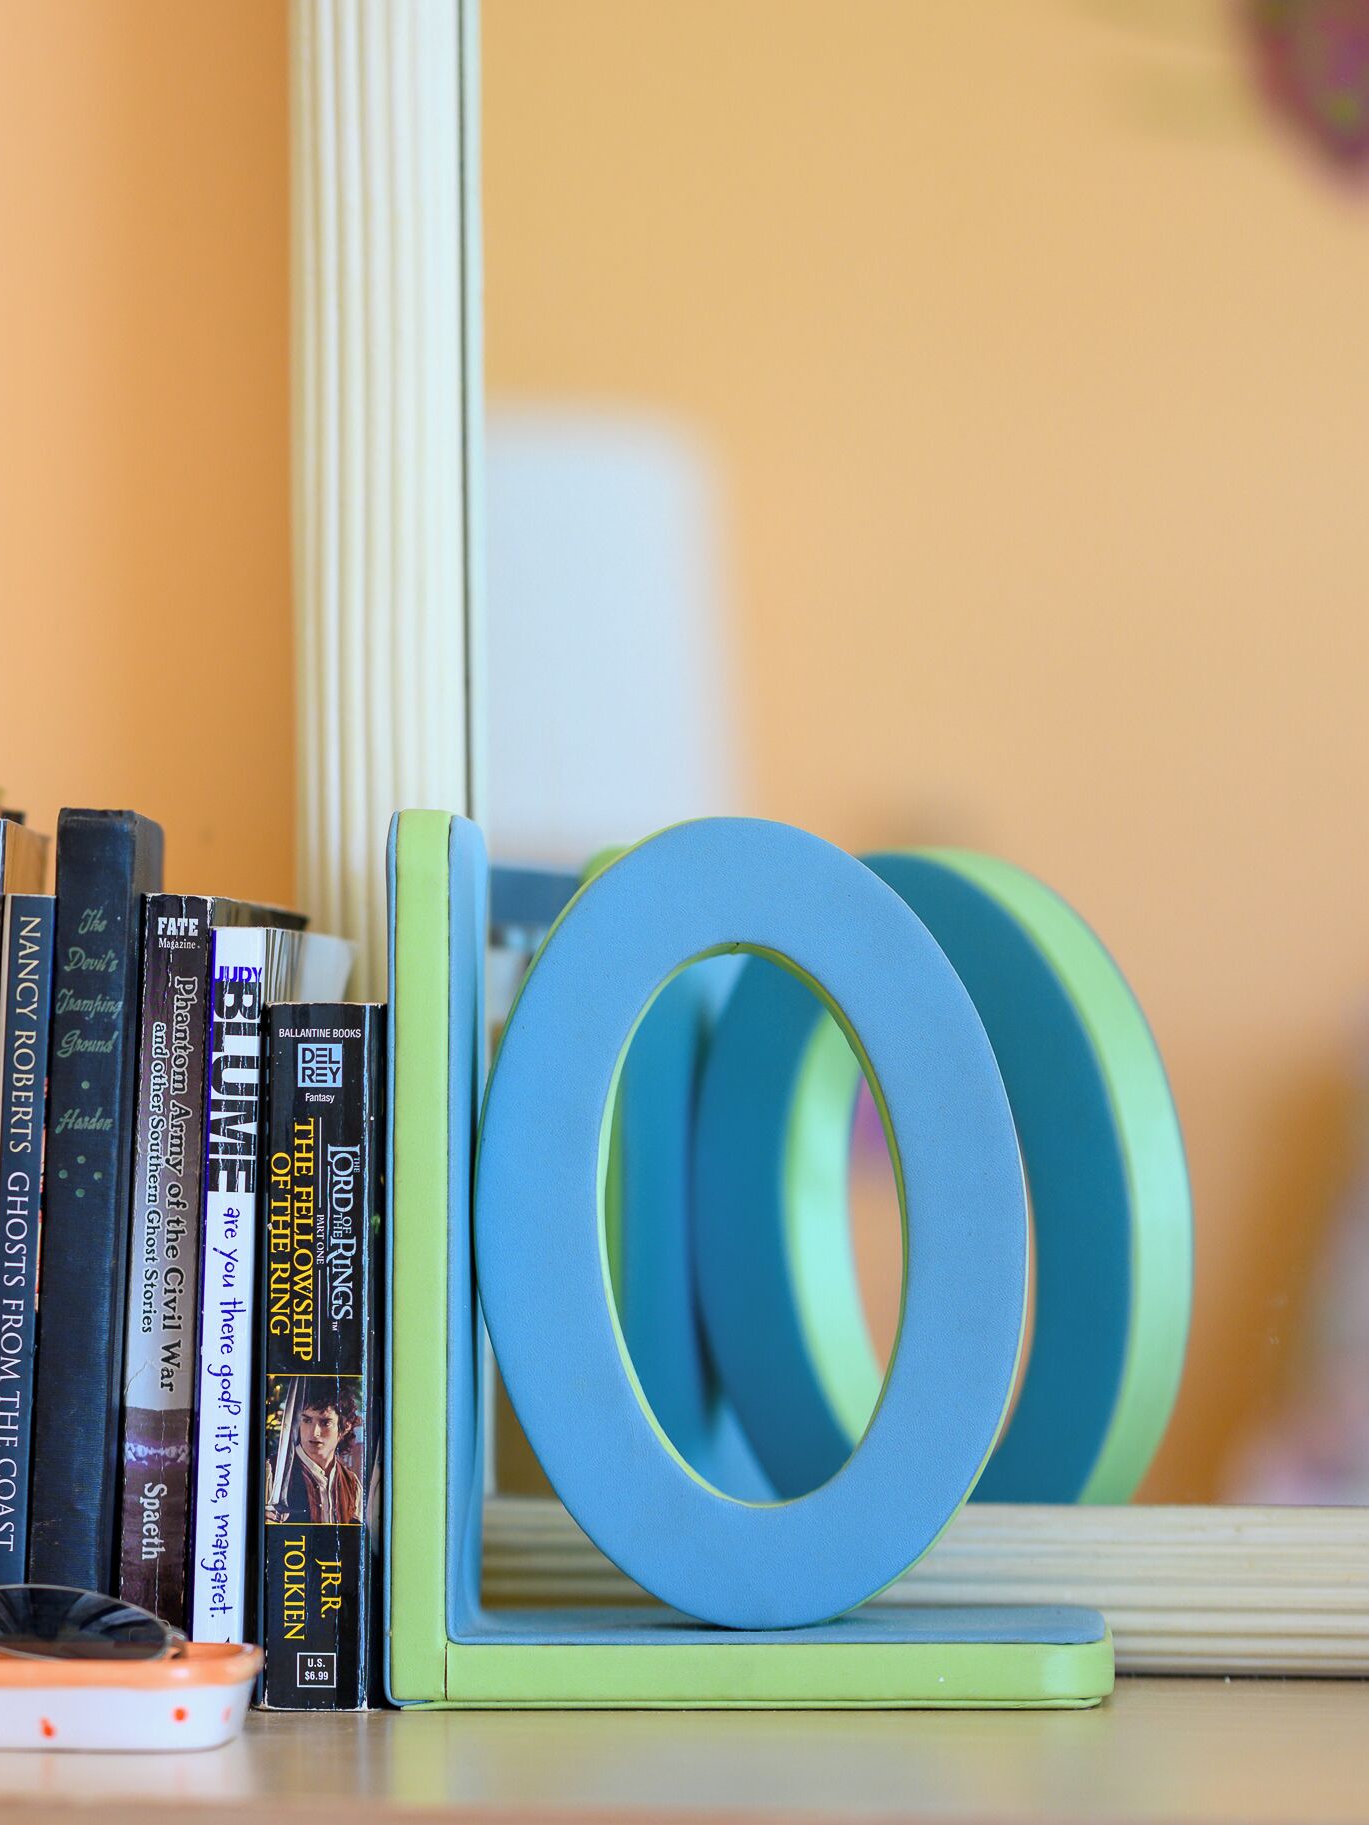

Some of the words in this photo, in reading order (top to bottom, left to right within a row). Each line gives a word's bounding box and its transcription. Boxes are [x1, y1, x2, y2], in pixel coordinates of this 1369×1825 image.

[78, 906, 108, 934] The
[157, 916, 199, 937] FATE
[14, 915, 42, 1021] NANCY
[214, 965, 263, 983] JUDY
[57, 1029, 119, 1059] Ground
[151, 1022, 167, 1057] and
[170, 976, 199, 1096] Phantom
[278, 1028, 331, 1039] BALLANTINE
[332, 1028, 362, 1039] BOOKS
[301, 1047, 340, 1065] DEL
[9, 1030, 36, 1153] ROBERTS
[149, 1057, 169, 1111] other
[208, 982, 262, 1193] BLUME
[301, 1066, 342, 1084] REY
[304, 1092, 335, 1104] Fantasy
[145, 1112, 166, 1204] Southern
[164, 1100, 193, 1179] Army
[294, 1117, 315, 1177] THE
[353, 1157, 361, 1173] THE
[166, 1181, 189, 1213] of
[270, 1152, 291, 1190] OF
[327, 1143, 361, 1213] LORD
[3, 1171, 31, 1287] GHOSTS
[142, 1208, 161, 1268] Ghost
[164, 1215, 187, 1258] the
[222, 1207, 241, 1239] are
[270, 1197, 291, 1254] THE
[316, 1214, 325, 1239] PART
[332, 1212, 343, 1238] THE
[342, 1216, 353, 1234] OF
[212, 1247, 239, 1289] you
[292, 1182, 314, 1362] FELLOWSHIP
[316, 1241, 325, 1265] ONE
[140, 1270, 160, 1335] Stories
[161, 1263, 185, 1330] Civil
[269, 1262, 291, 1336] RING
[0, 1298, 25, 1381] FROM
[218, 1297, 247, 1356] there
[159, 1338, 183, 1393] War
[207, 1363, 242, 1416] god?
[214, 1423, 239, 1456] it's
[209, 1461, 234, 1504] me,
[140, 1482, 168, 1561] Spaeth
[200, 1513, 234, 1618] margaret.
[283, 1535, 306, 1641] TOLKIEN
[315, 1559, 342, 1619] J.R.R.
[304, 1670, 330, 1682] $6.99
[307, 1657, 327, 1669] U.S.
